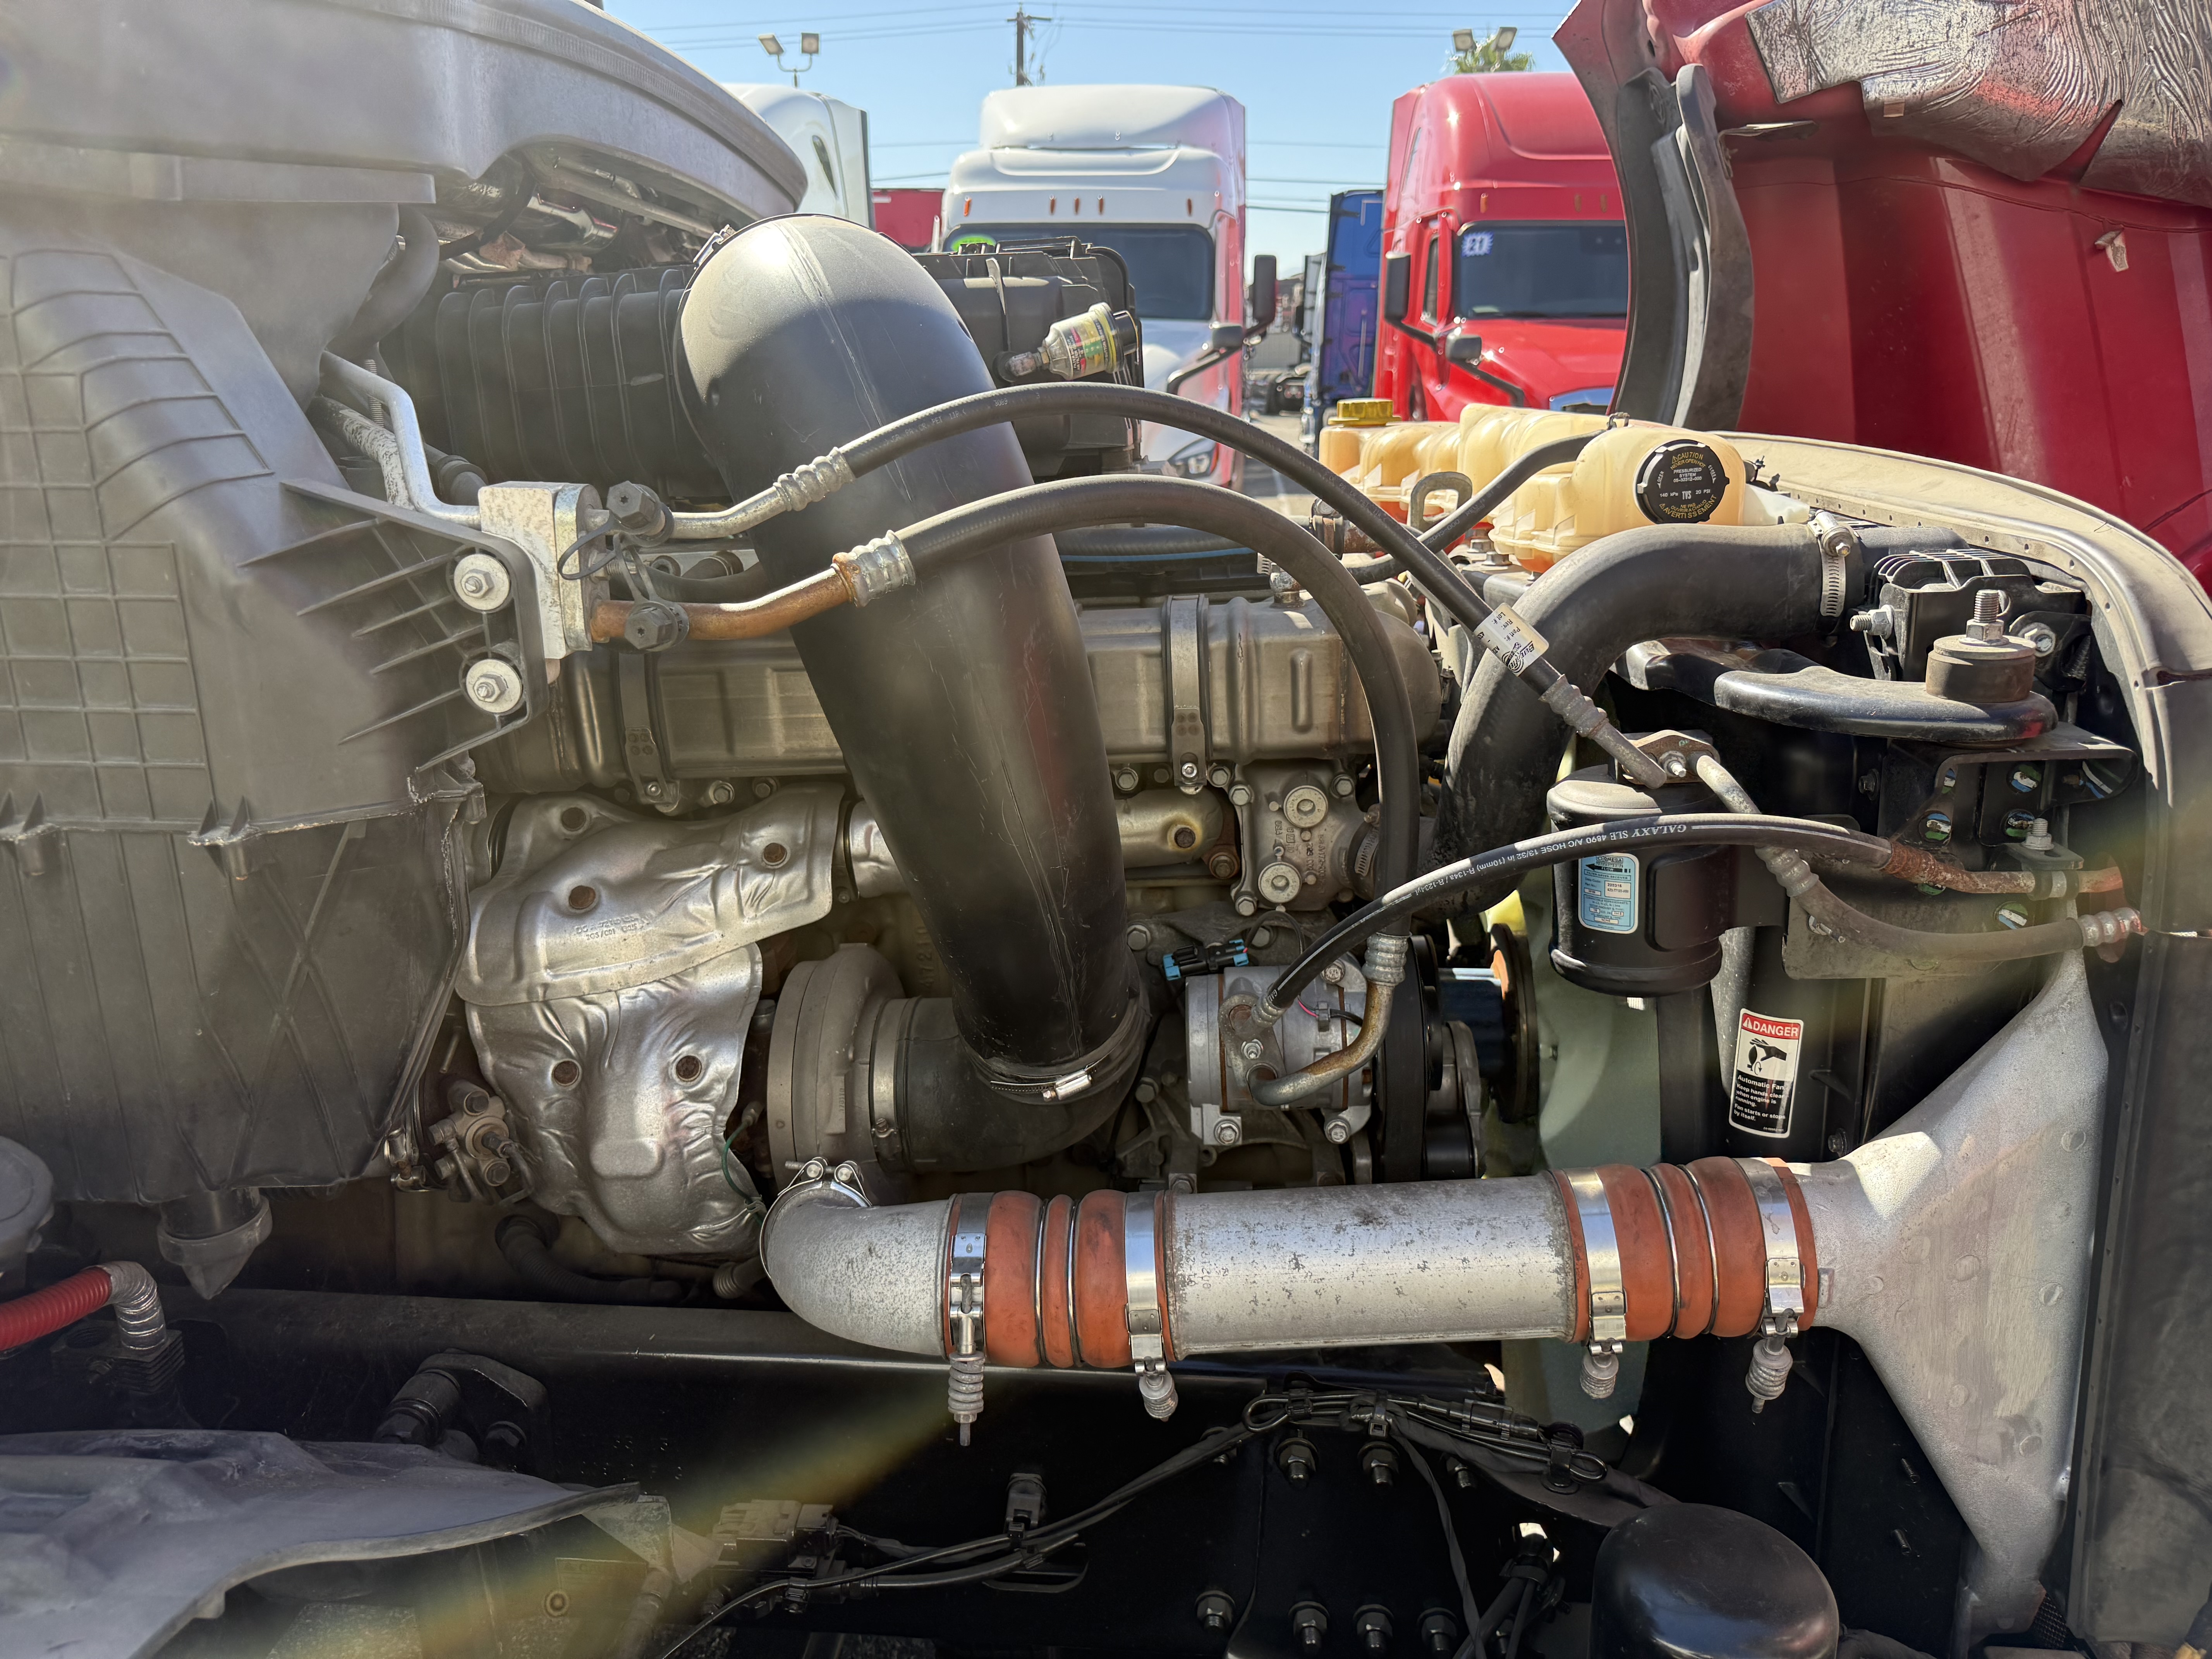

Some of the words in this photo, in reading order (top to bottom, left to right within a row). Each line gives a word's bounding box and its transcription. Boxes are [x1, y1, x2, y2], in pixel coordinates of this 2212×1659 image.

[1670, 460, 1685, 470] NEVER
[1682, 491, 1691, 500] TVS
[1663, 495, 1717, 519] AVERTISSEMENT
[1692, 500, 1707, 510] CHAUD
[1496, 611, 1505, 620] Lot
[1509, 626, 1520, 637] Part
[1610, 831, 1628, 840] SLE
[1632, 824, 1686, 838] GALAXY
[1568, 838, 1583, 847] A/C
[1586, 835, 1606, 844] 4890
[1541, 843, 1566, 854] HOSE
[1516, 849, 1539, 860] 13/32
[1476, 856, 1506, 871] (10mm)
[1450, 867, 1475, 880] R-134a
[1753, 1021, 1798, 1037] DANGER
[1738, 1075, 1770, 1088] Automatic
[1737, 1084, 1750, 1092] Keep
[1751, 1089, 1768, 1097] hands
[1735, 1097, 1757, 1107] running.
[1741, 1113, 1756, 1121] itself.
[1744, 1108, 1760, 1116] starts
